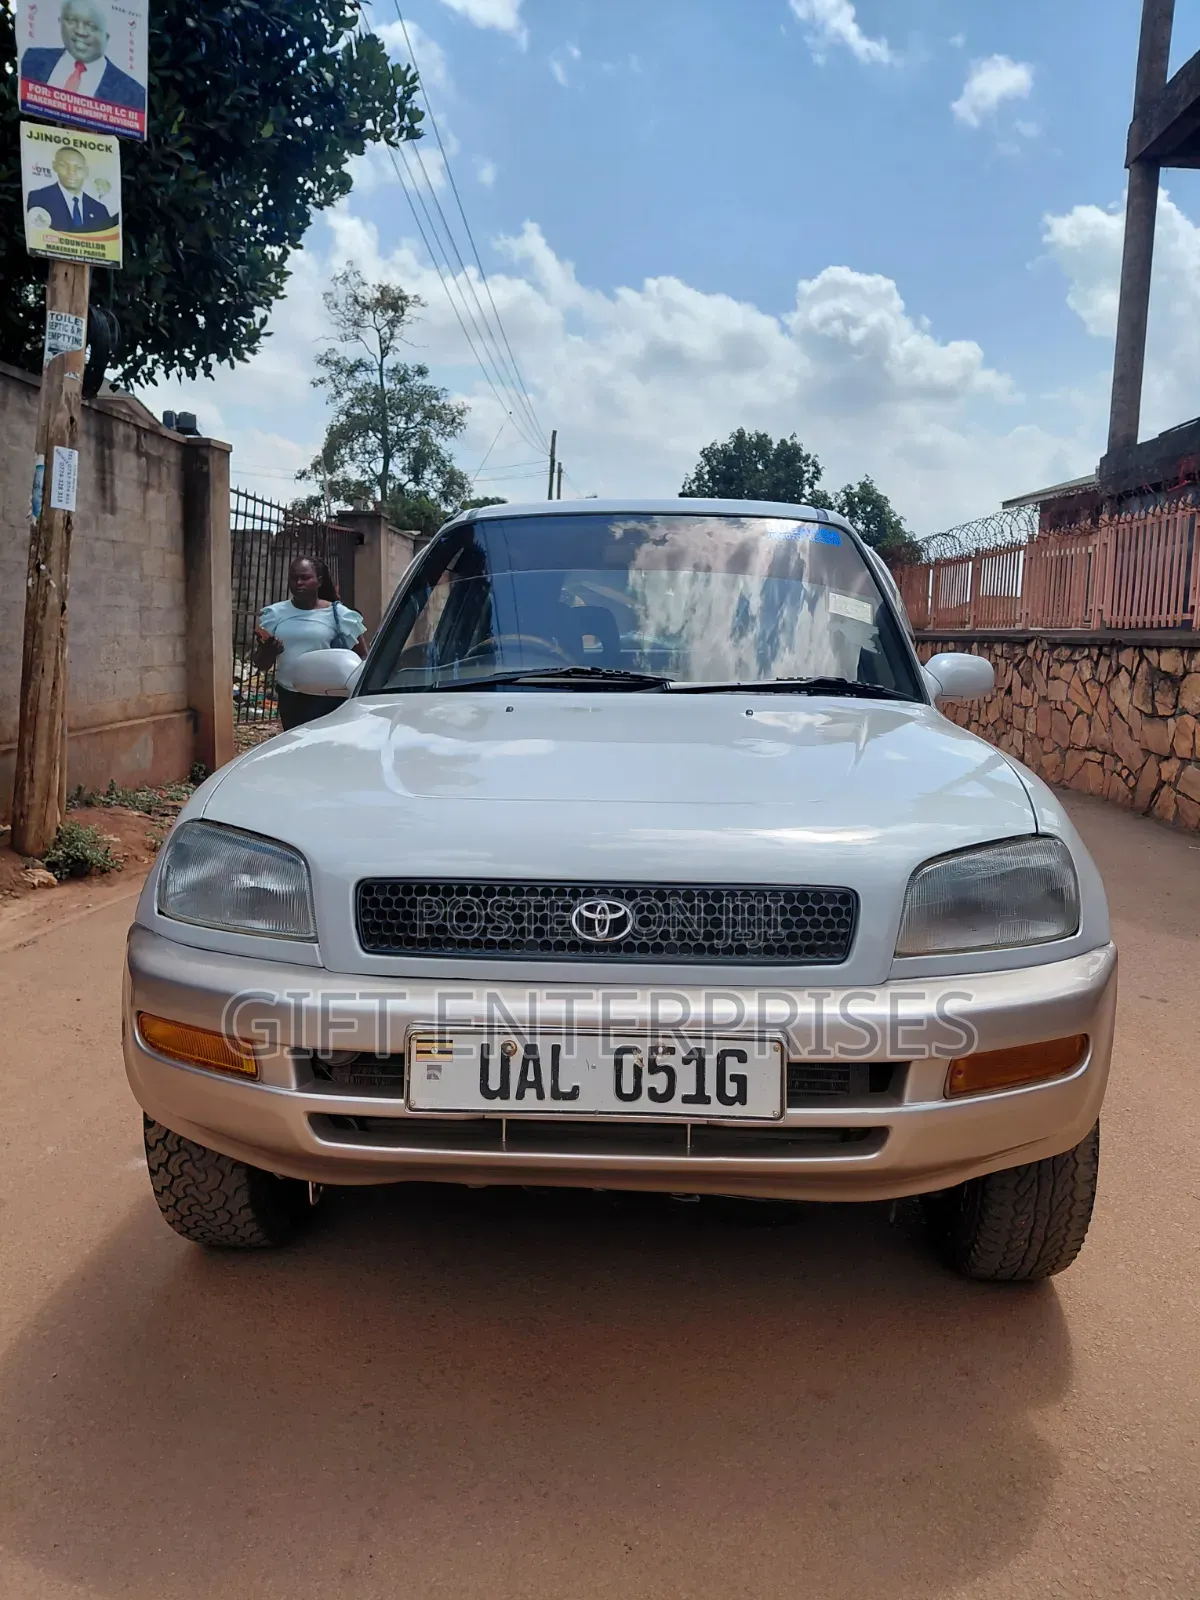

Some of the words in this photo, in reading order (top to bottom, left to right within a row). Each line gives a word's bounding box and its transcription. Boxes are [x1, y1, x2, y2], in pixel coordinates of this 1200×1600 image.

[26, 92, 67, 110] MAKERERE
[72, 106, 108, 120] KAWEMPE
[108, 114, 140, 130] DIVISION
[28, 83, 51, 98] FOR:
[54, 92, 112, 114] COUNCILLOR
[114, 107, 126, 118] LC
[128, 111, 138, 120] III
[26, 130, 70, 146] JJINGO
[72, 138, 113, 154] ENOCK
[59, 236, 106, 250] COUNCILLOR
[48, 321, 68, 332] SEPTIC
[50, 312, 84, 328] TOILET
[48, 332, 82, 347] EMPTYING
[479, 1042, 580, 1101] UAL
[613, 1045, 748, 1106] 051G
